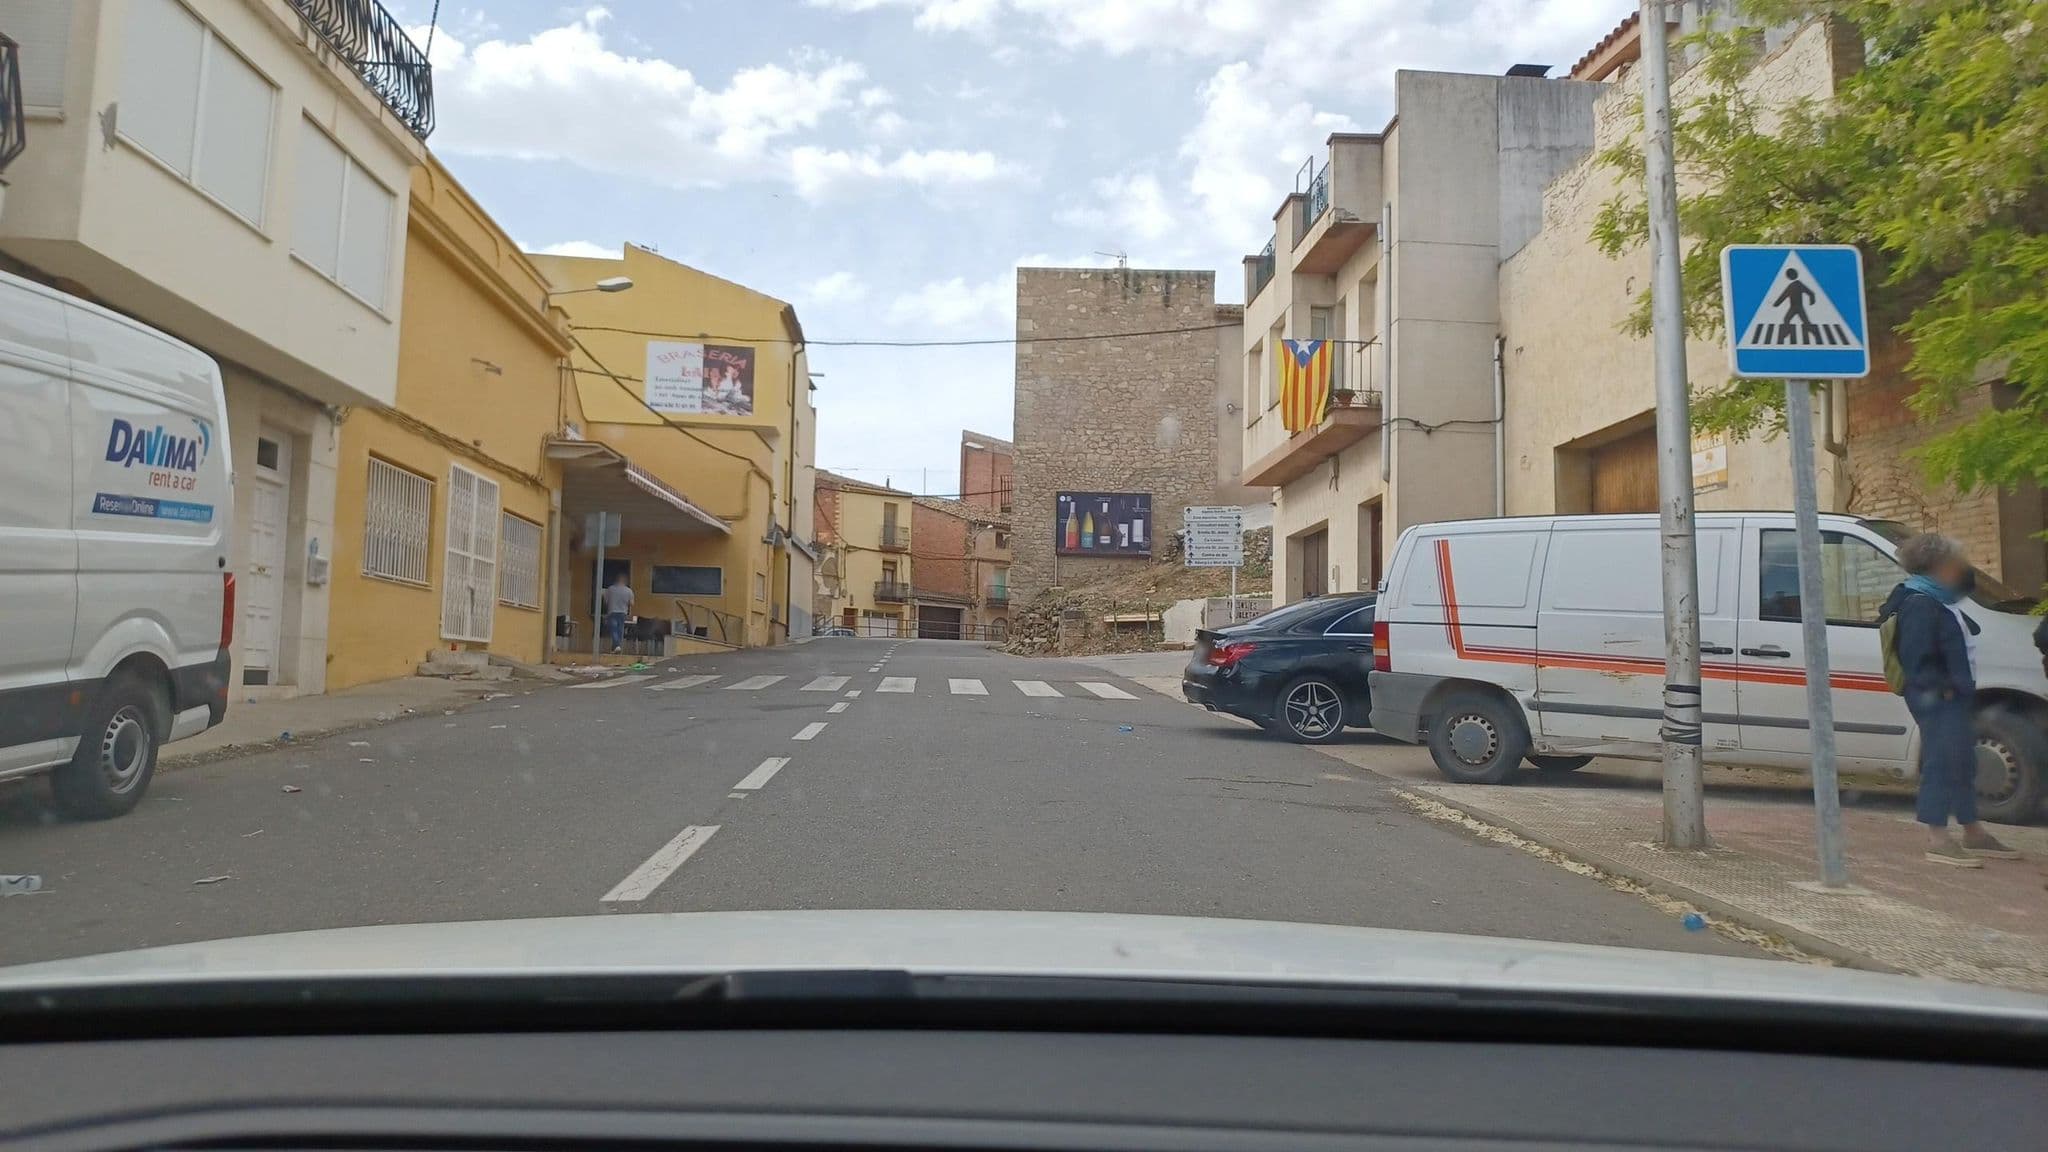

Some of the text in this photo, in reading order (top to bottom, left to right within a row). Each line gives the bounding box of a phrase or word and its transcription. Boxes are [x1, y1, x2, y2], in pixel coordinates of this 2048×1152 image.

[105, 418, 197, 472] DAVIMA
[148, 471, 197, 491] rent a car
[132, 499, 154, 515] Online
